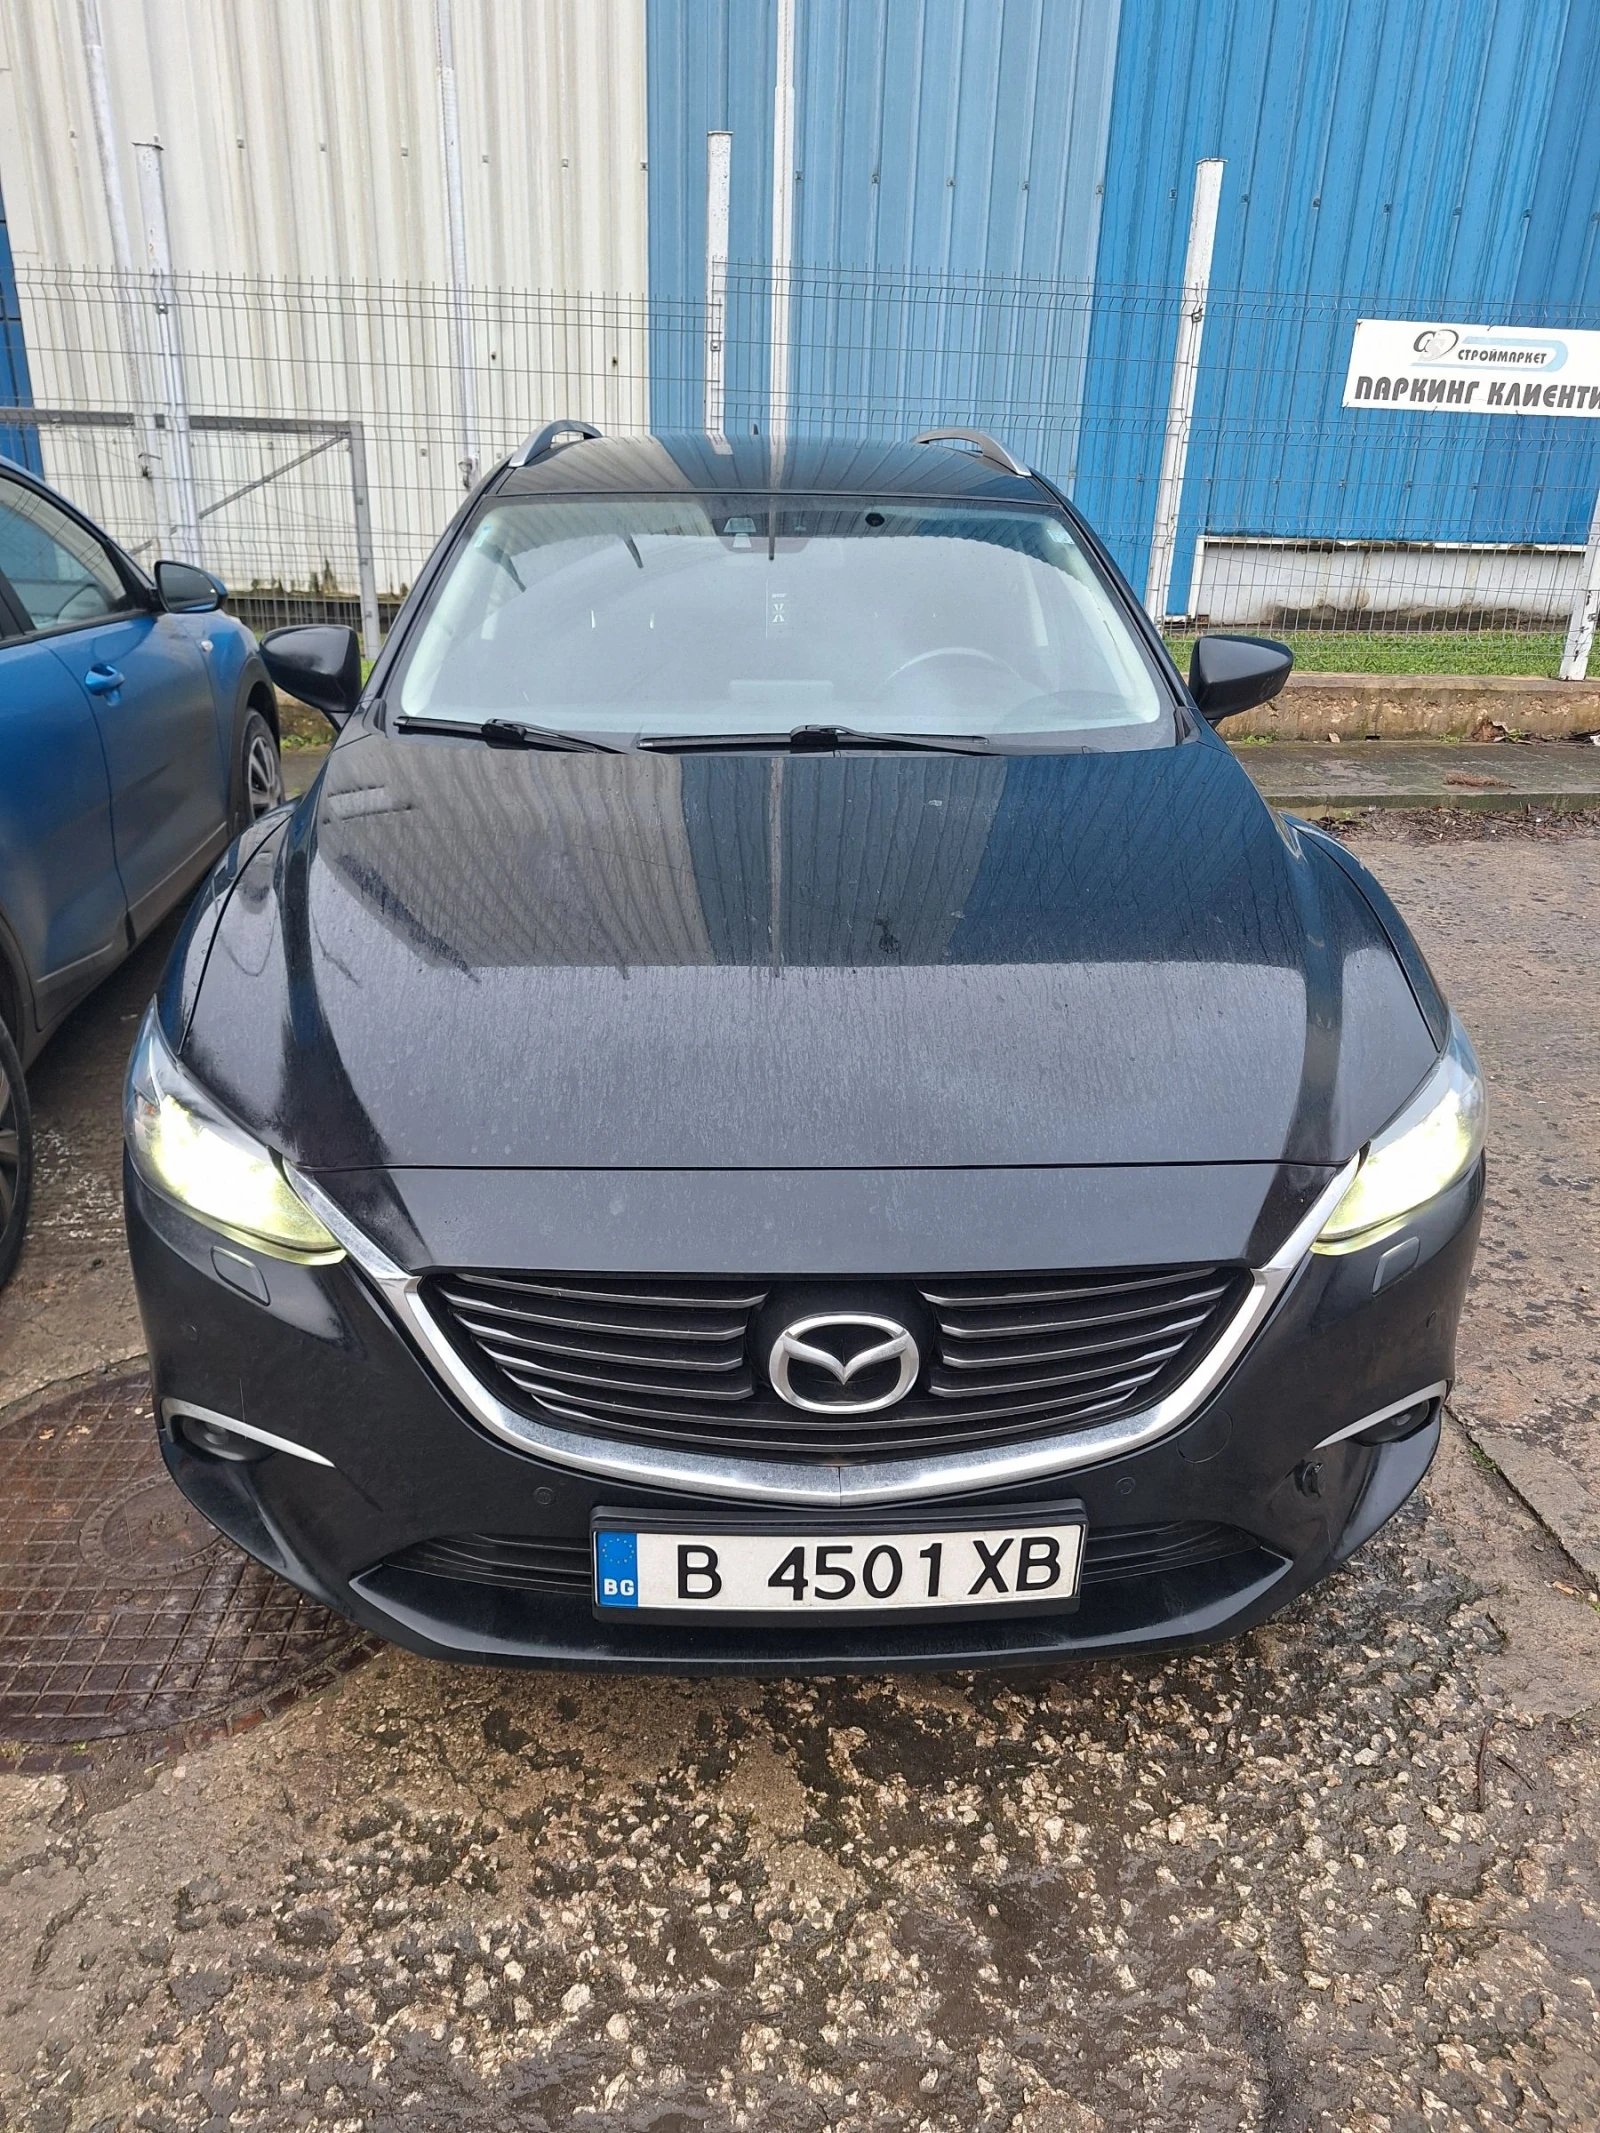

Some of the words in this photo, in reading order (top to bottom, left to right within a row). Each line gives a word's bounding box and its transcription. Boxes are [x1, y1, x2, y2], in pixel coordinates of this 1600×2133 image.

[1457, 348, 1547, 364] СТРОЙМАРКЕТ
[1354, 375, 1480, 405] ПАРКИНГ
[677, 1544, 722, 1600] B
[767, 1542, 943, 1602] 4501
[967, 1536, 1062, 1595] XB
[603, 1578, 635, 1597] BG
